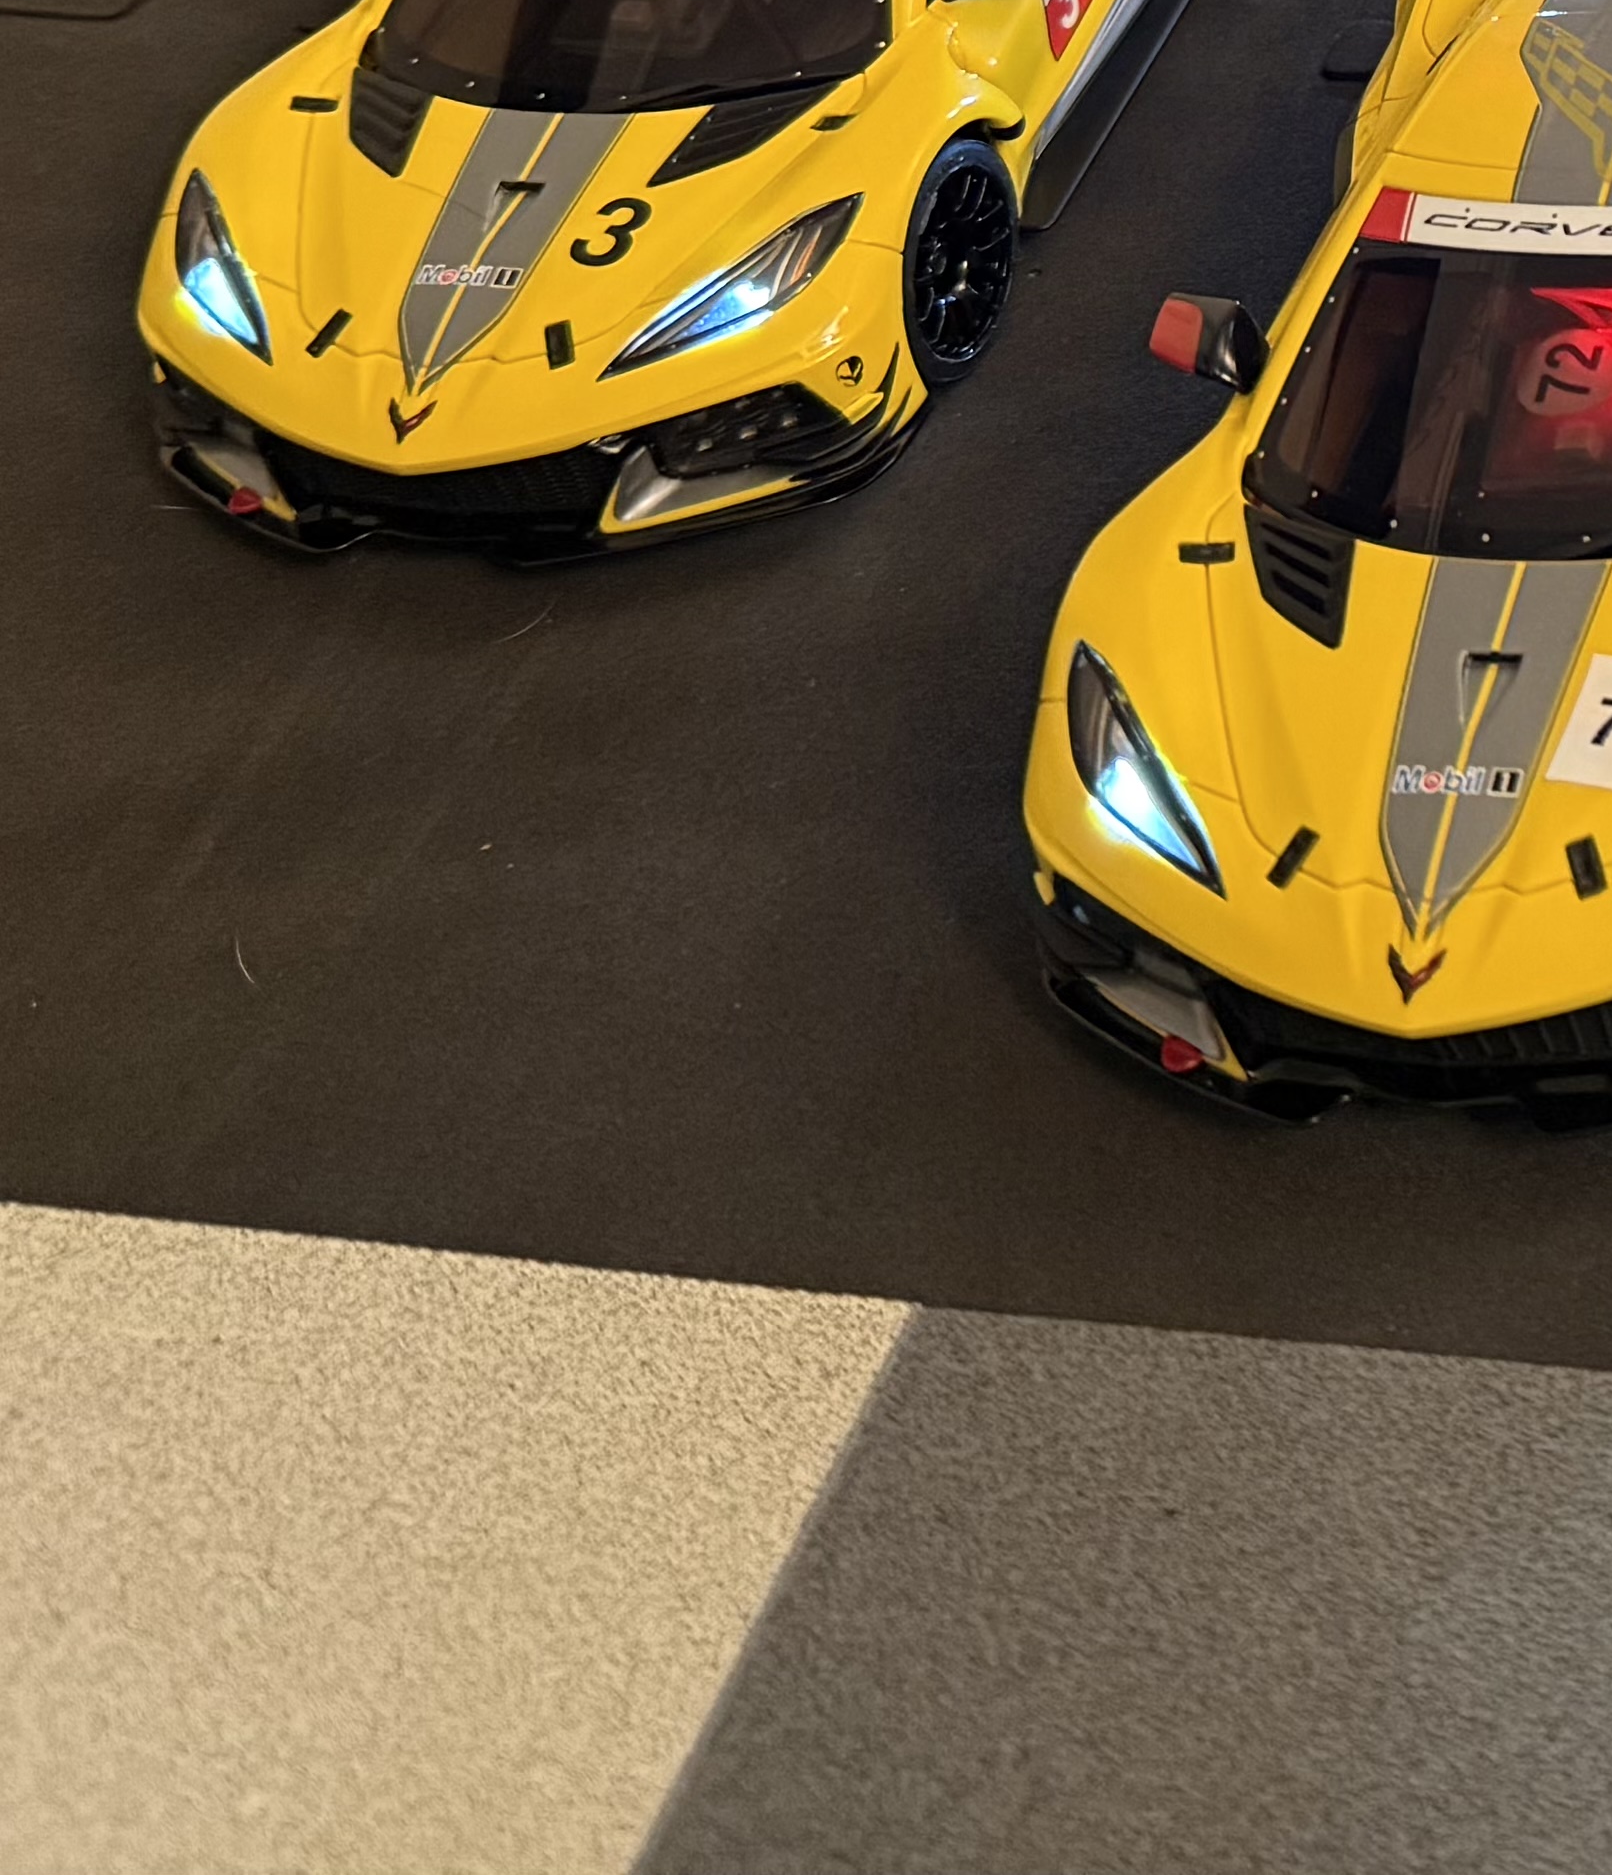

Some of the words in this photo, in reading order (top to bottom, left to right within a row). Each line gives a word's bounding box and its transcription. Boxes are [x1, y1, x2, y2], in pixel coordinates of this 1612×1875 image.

[568, 196, 653, 268] 3
[415, 263, 494, 287] Mobil
[1533, 342, 1605, 404] 72
[1392, 764, 1487, 796] Mobil
